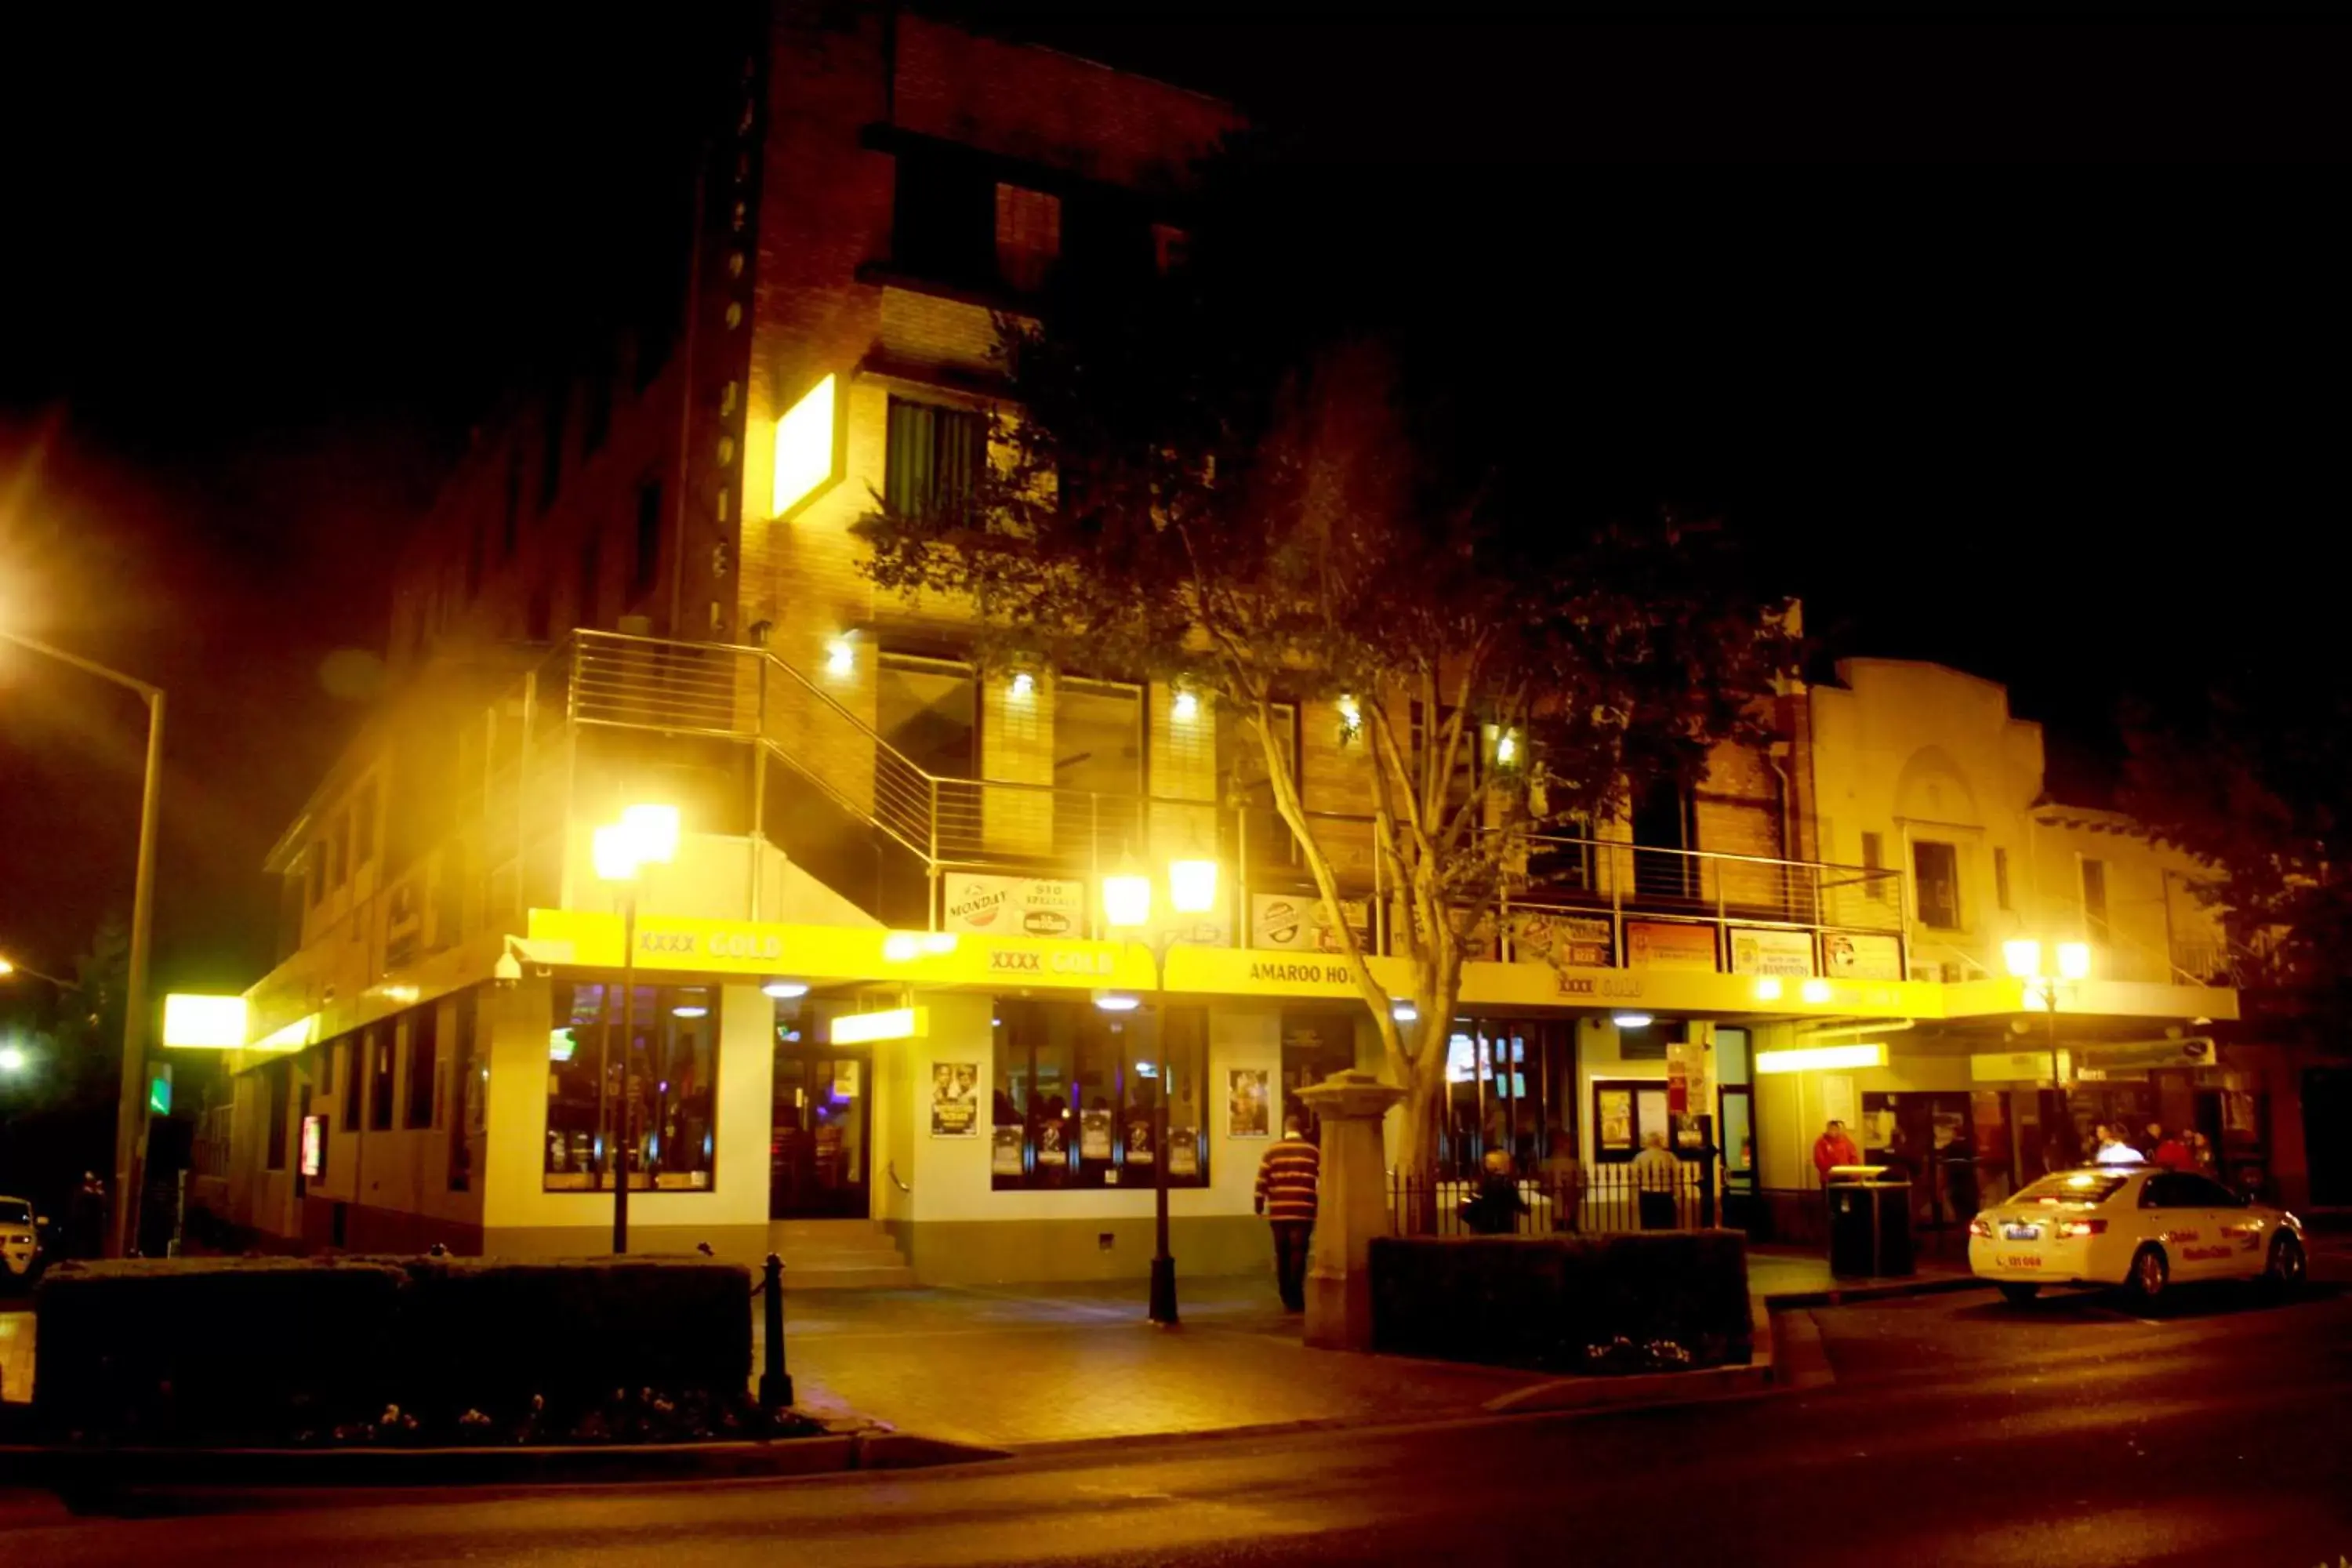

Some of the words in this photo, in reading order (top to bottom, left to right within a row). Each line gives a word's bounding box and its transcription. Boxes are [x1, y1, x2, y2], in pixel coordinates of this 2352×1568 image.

[950, 890, 1008, 917] MONDAY
[640, 932, 694, 953] XXXX
[709, 933, 782, 961] GOLD
[992, 951, 1040, 971] XXXX
[1052, 952, 1114, 976] GOLD
[1250, 962, 1320, 983] AMAROO
[1558, 977, 1595, 994] XXXX
[1601, 976, 1644, 998] GOLD
